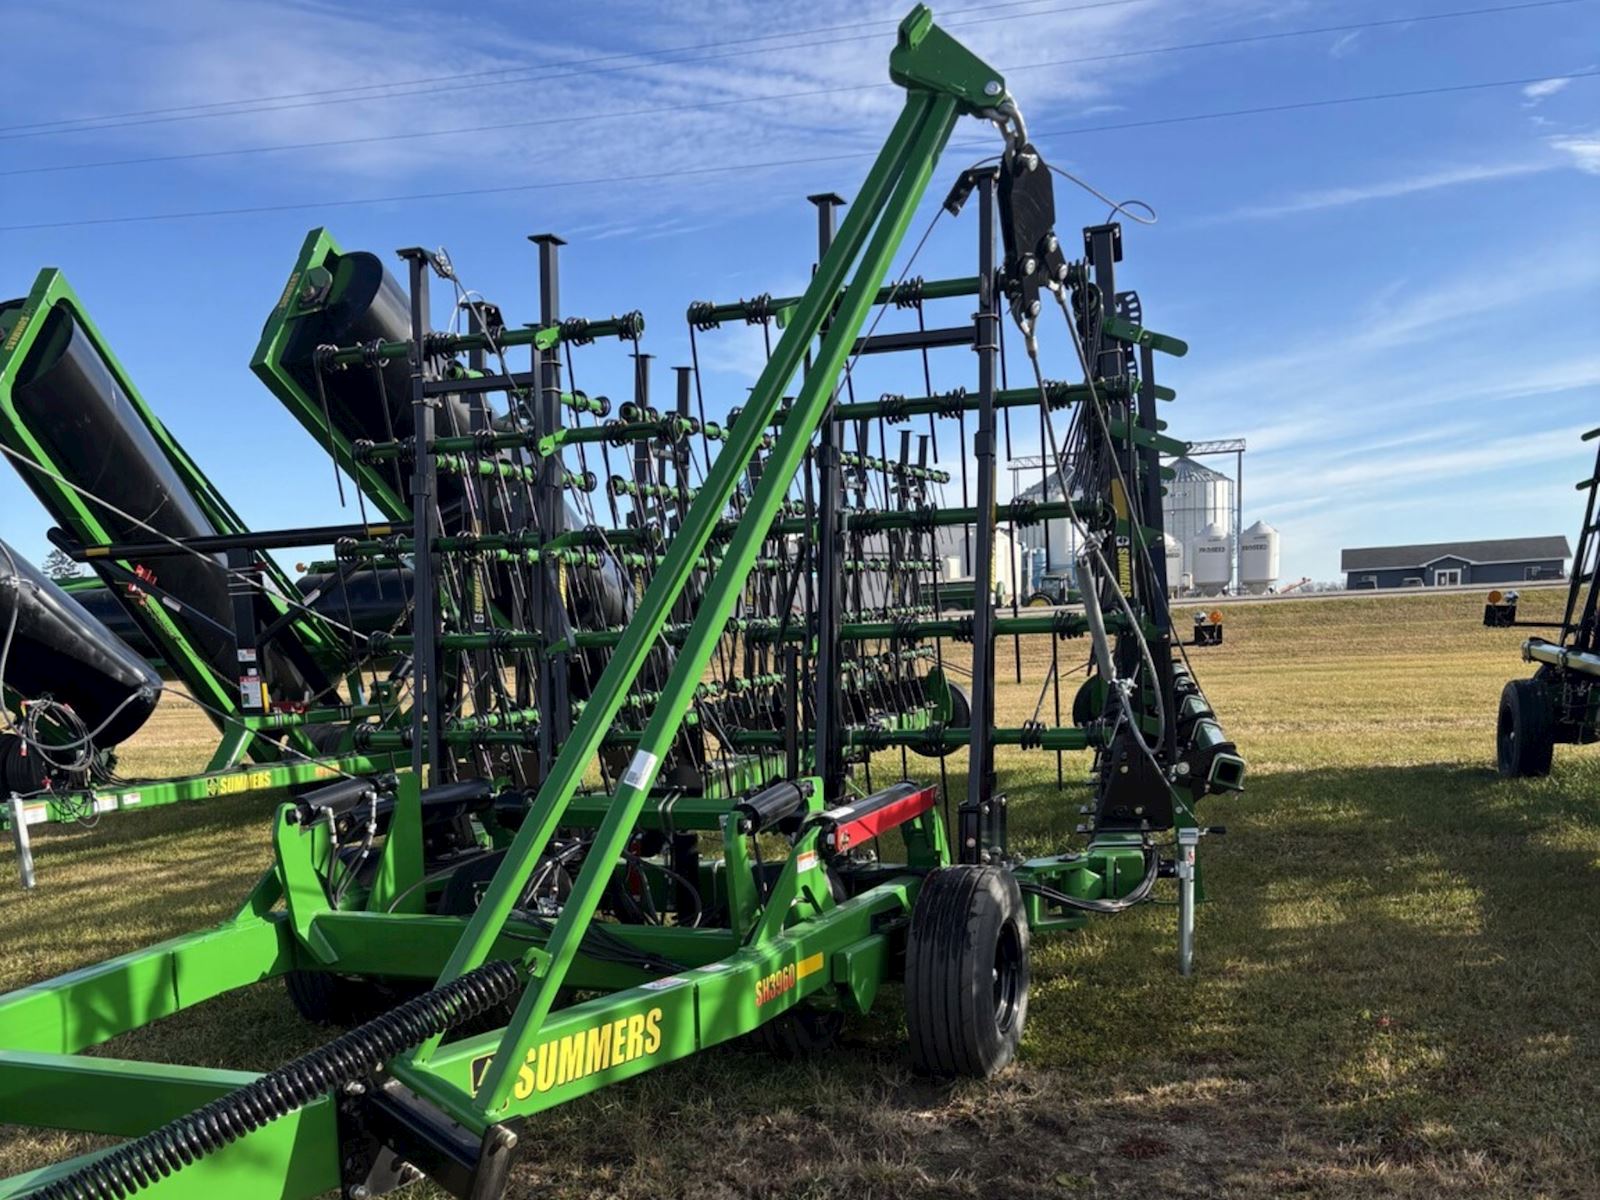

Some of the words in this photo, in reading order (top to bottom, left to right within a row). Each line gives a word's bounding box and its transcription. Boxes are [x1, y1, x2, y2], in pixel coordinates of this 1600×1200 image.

[220, 770, 272, 794] SUMMERS
[755, 962, 796, 1008] SH3960
[514, 1007, 663, 1100] SUMMERS
